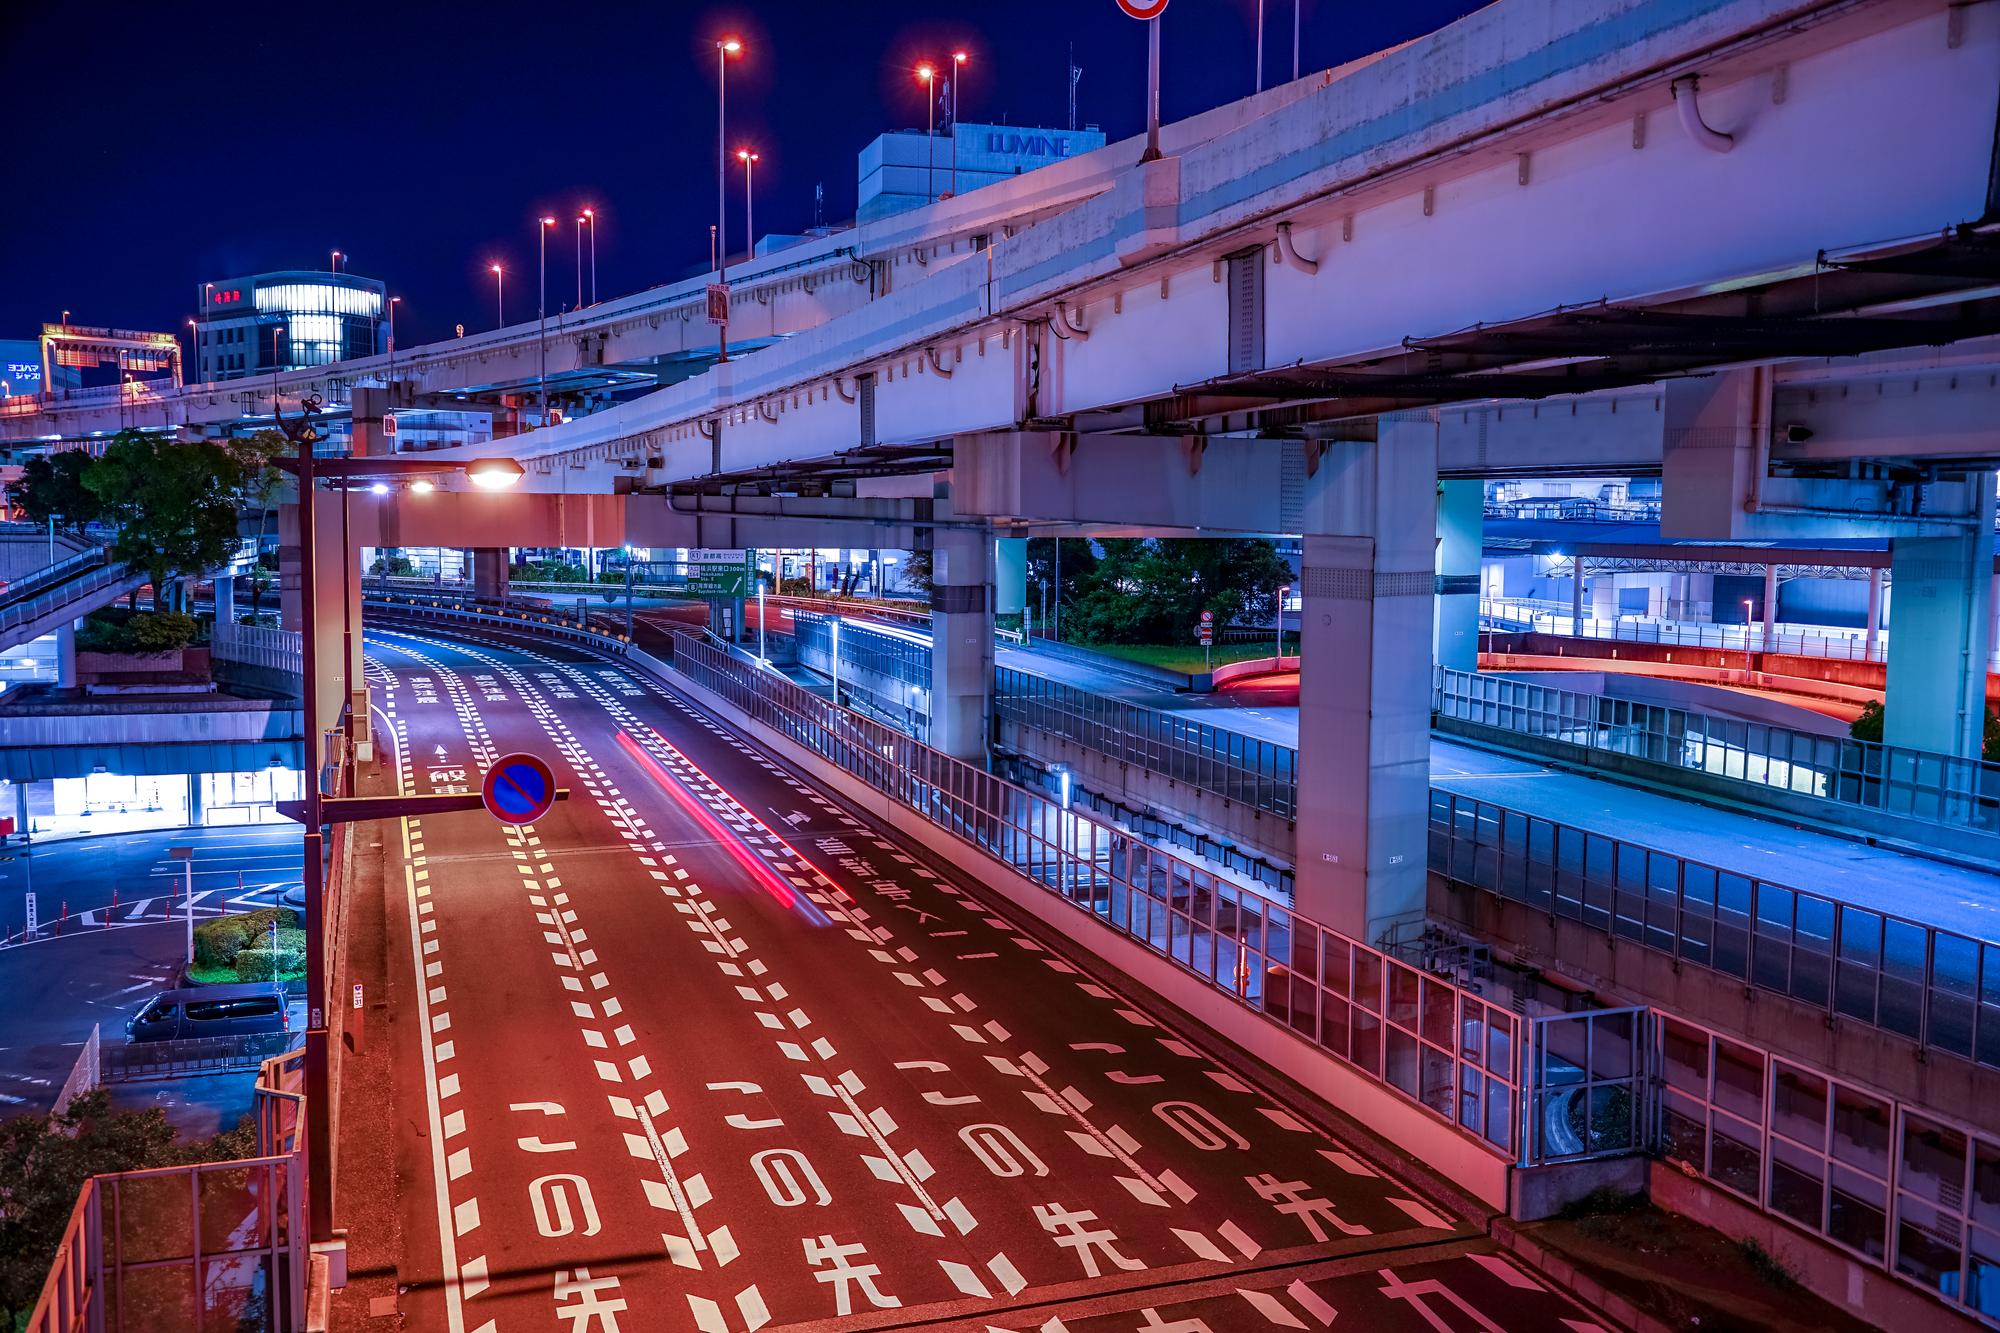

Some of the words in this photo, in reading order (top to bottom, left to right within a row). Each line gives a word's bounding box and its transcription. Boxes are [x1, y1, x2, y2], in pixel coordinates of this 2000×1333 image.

[987, 132, 1071, 157] LUMINE
[8, 364, 39, 372] ヨコハマ
[15, 372, 41, 380] ジャズ
[705, 1081, 903, 1317] この先
[509, 1100, 629, 1333] この先
